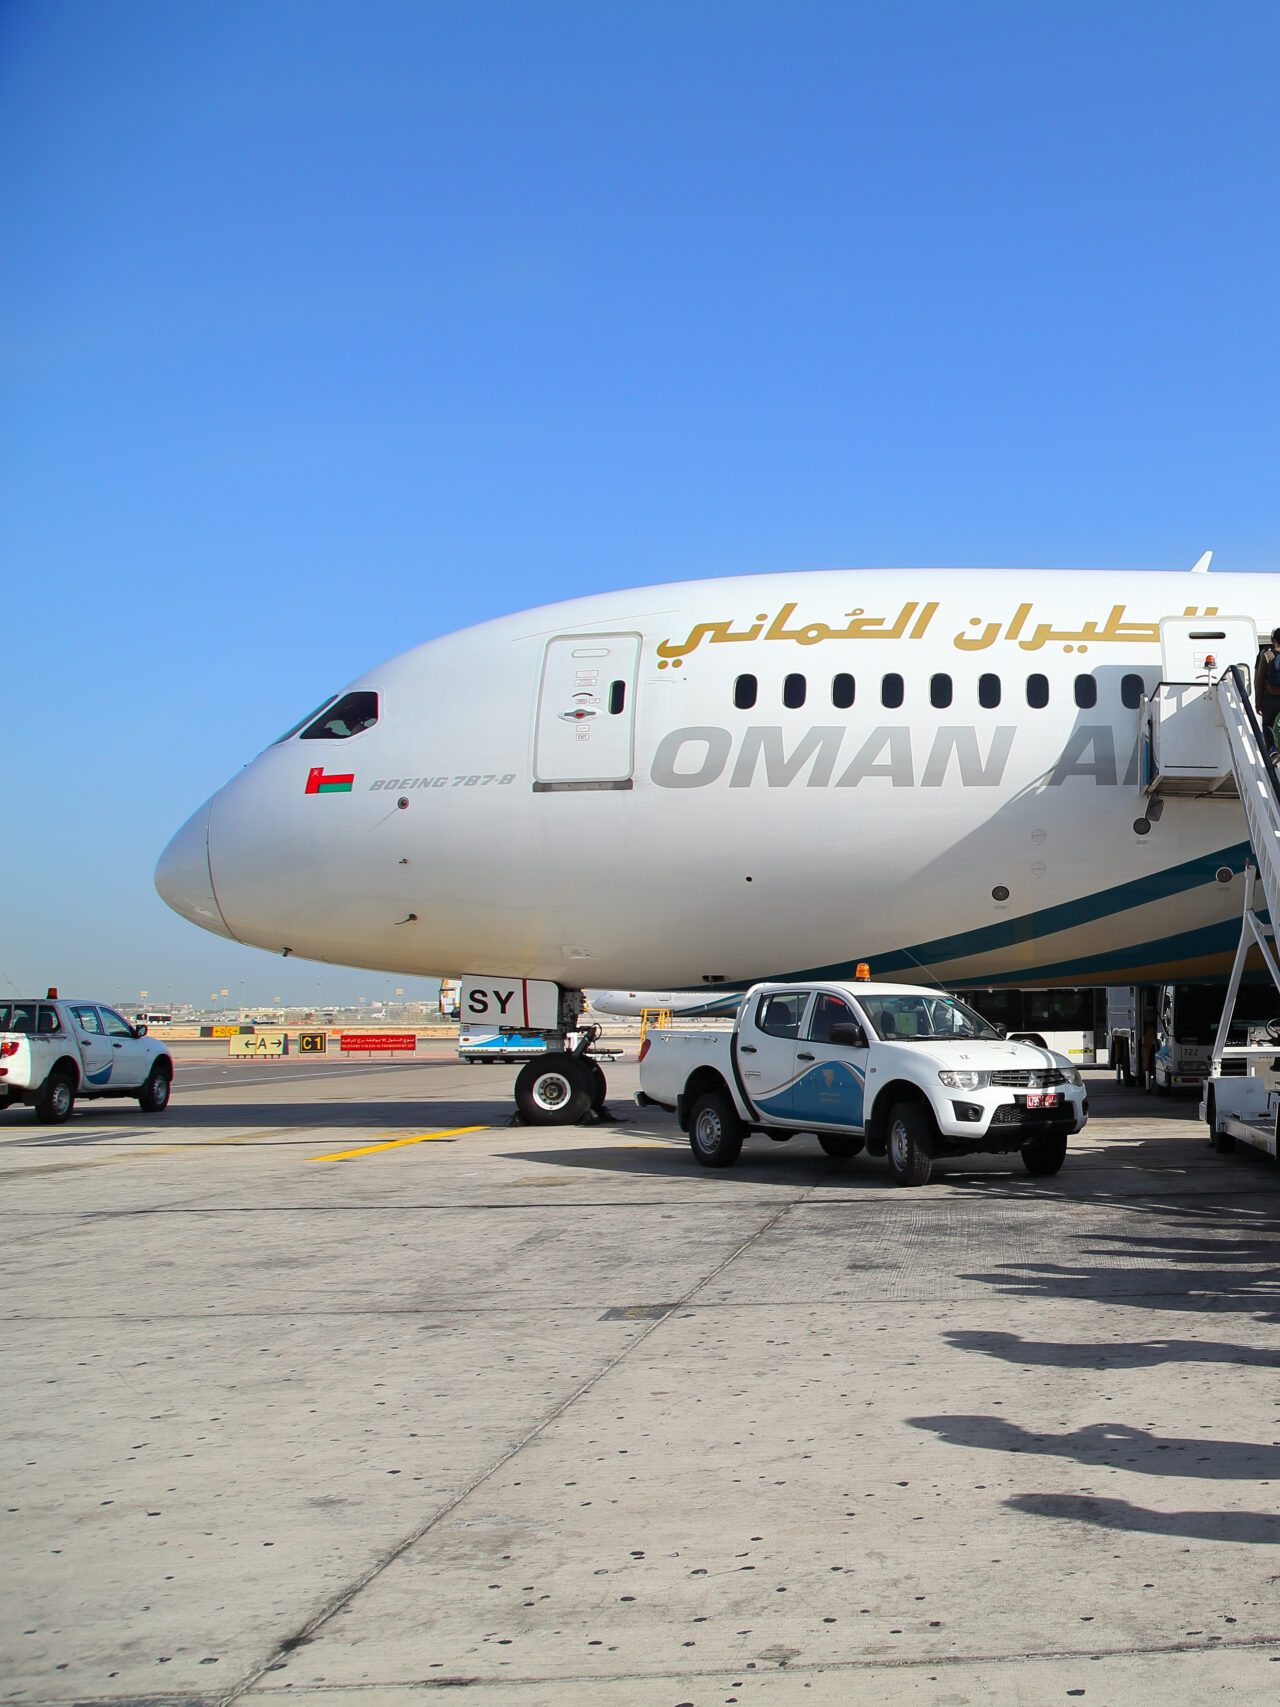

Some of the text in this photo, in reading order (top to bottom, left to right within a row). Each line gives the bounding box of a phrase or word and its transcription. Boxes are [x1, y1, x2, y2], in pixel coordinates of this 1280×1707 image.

[953, 603, 1219, 654] طيران
[650, 726, 1018, 789] OMAN
[368, 776, 449, 791] BOEING
[468, 989, 515, 1015] SY
[257, 1038, 268, 1050] A
[302, 1036, 322, 1050] C1
[1184, 1048, 1199, 1056] 722
